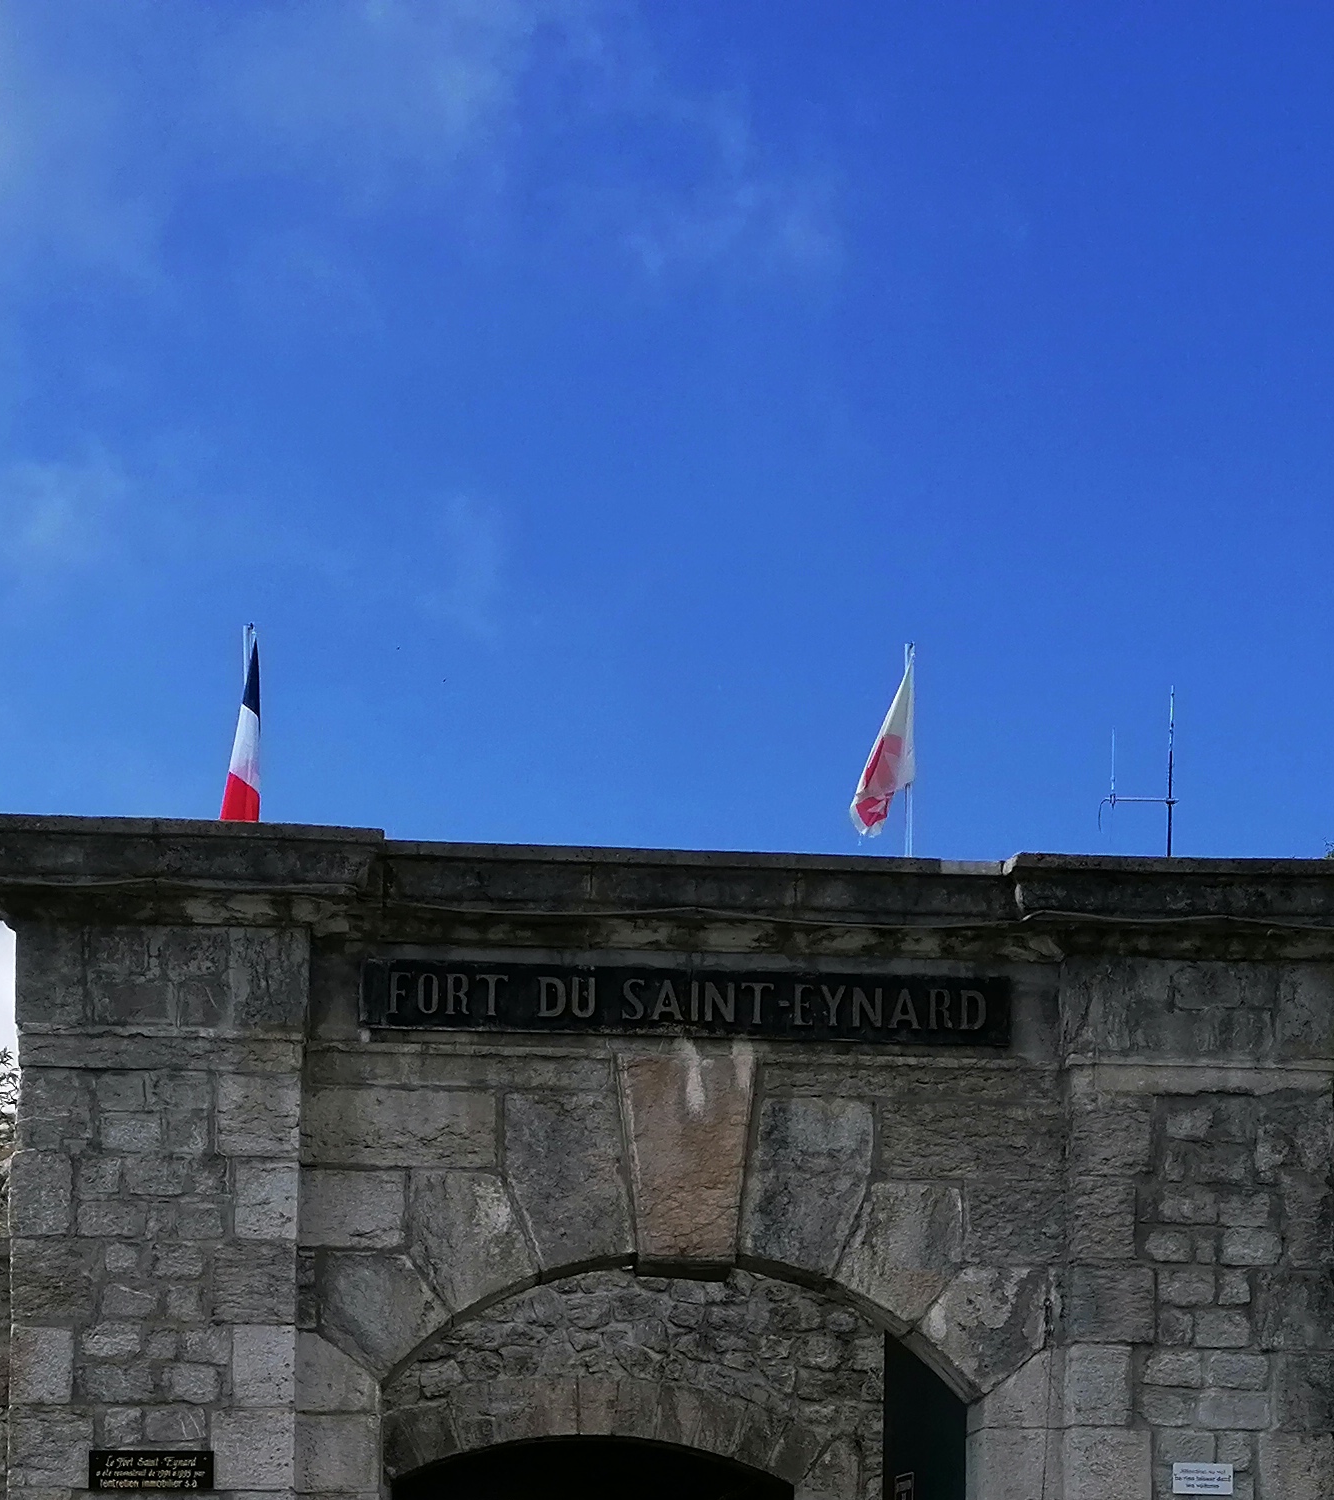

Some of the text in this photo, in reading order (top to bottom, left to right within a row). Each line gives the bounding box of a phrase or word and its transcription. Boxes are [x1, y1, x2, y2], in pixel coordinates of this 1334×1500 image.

[387, 972, 988, 1031] FORT DU SAINT-EYNARD
[105, 1455, 115, 1467] Le
[116, 1456, 134, 1468] Fort
